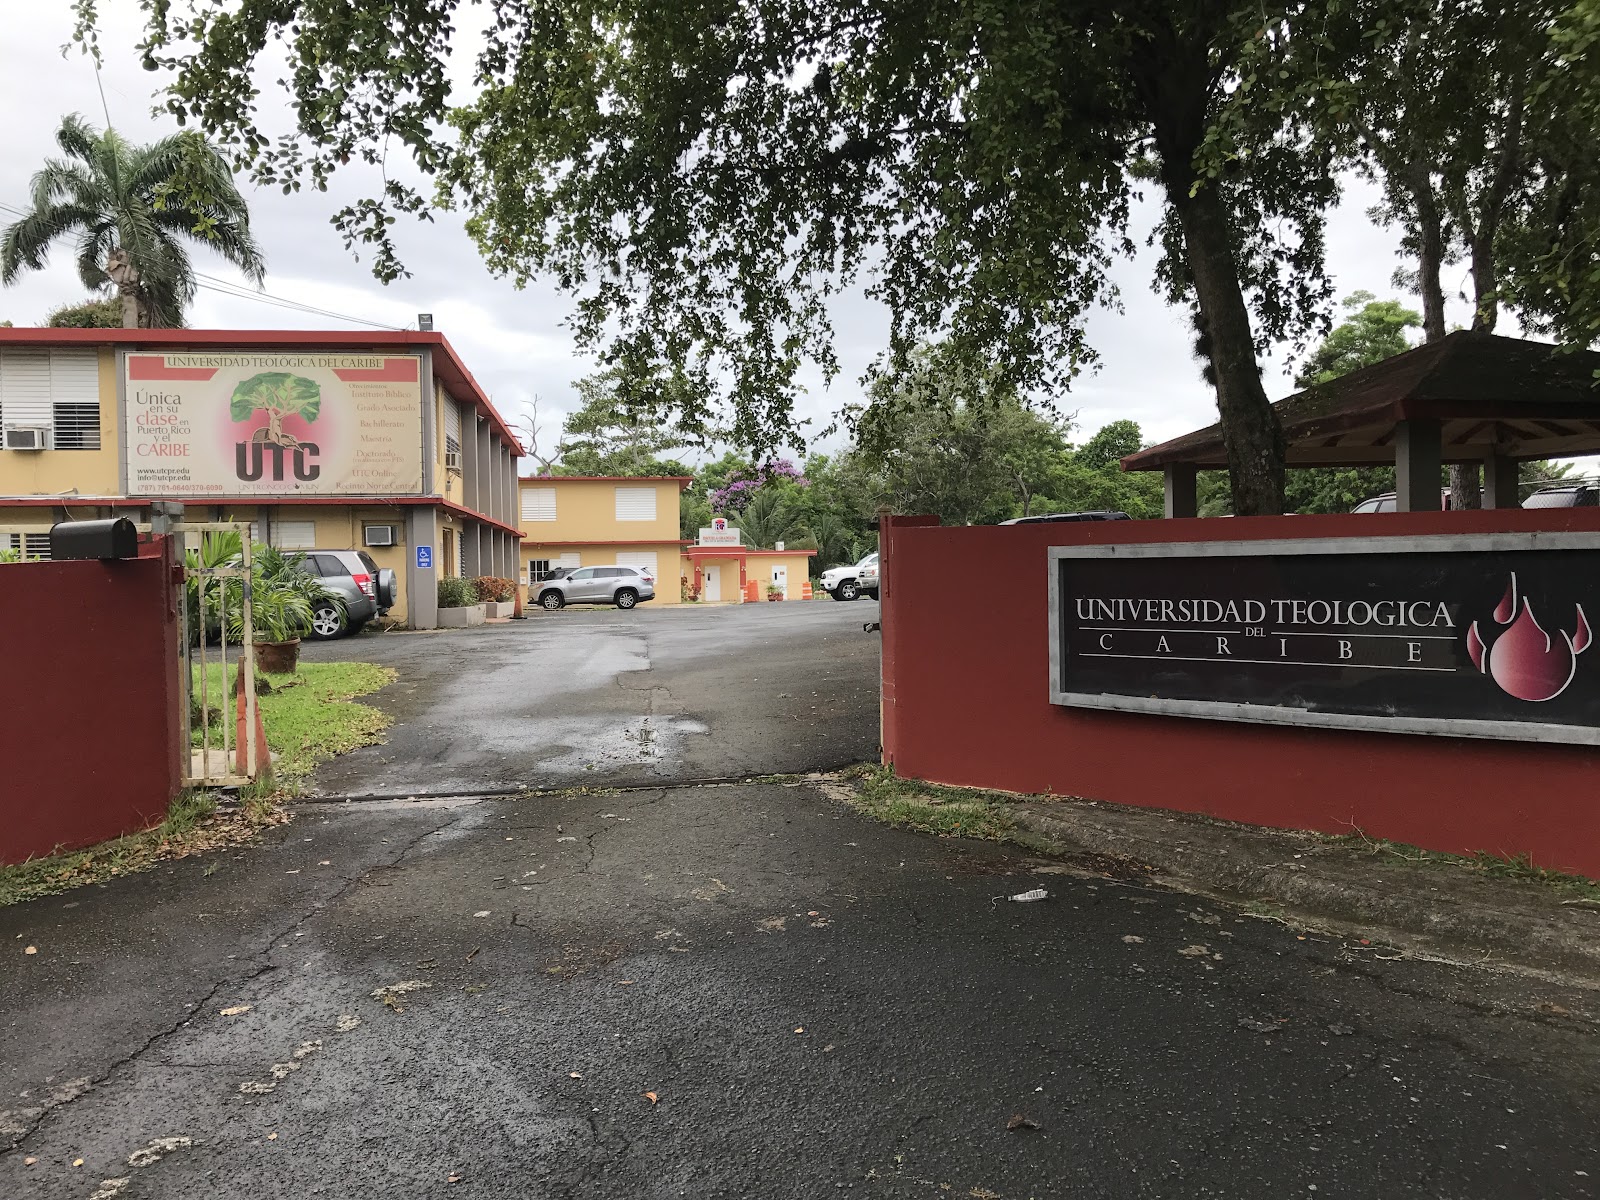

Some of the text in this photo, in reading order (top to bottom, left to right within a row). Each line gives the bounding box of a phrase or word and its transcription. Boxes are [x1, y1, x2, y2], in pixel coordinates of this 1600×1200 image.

[167, 356, 250, 367] UNIVERSIDAD
[319, 358, 340, 368] DEL
[341, 359, 383, 368] CARIBE
[136, 388, 182, 405] Única
[351, 390, 384, 398] Instituto
[149, 405, 179, 413] en su
[136, 411, 178, 426] clase
[360, 420, 405, 428] Bachillerato
[137, 426, 191, 435] Puerto Rico
[161, 433, 171, 442] el
[136, 443, 191, 457] CARIBE
[236, 442, 320, 482] UTC
[137, 468, 190, 476] www.utcpr.edu
[352, 469, 397, 477] UTC Online
[137, 474, 191, 482] info@utcpr.edu
[336, 482, 418, 490] Recinto Norte Central
[1075, 598, 1457, 628] UNIVERSIDAD TEOLOGICA
[1245, 627, 1267, 637] DEL
